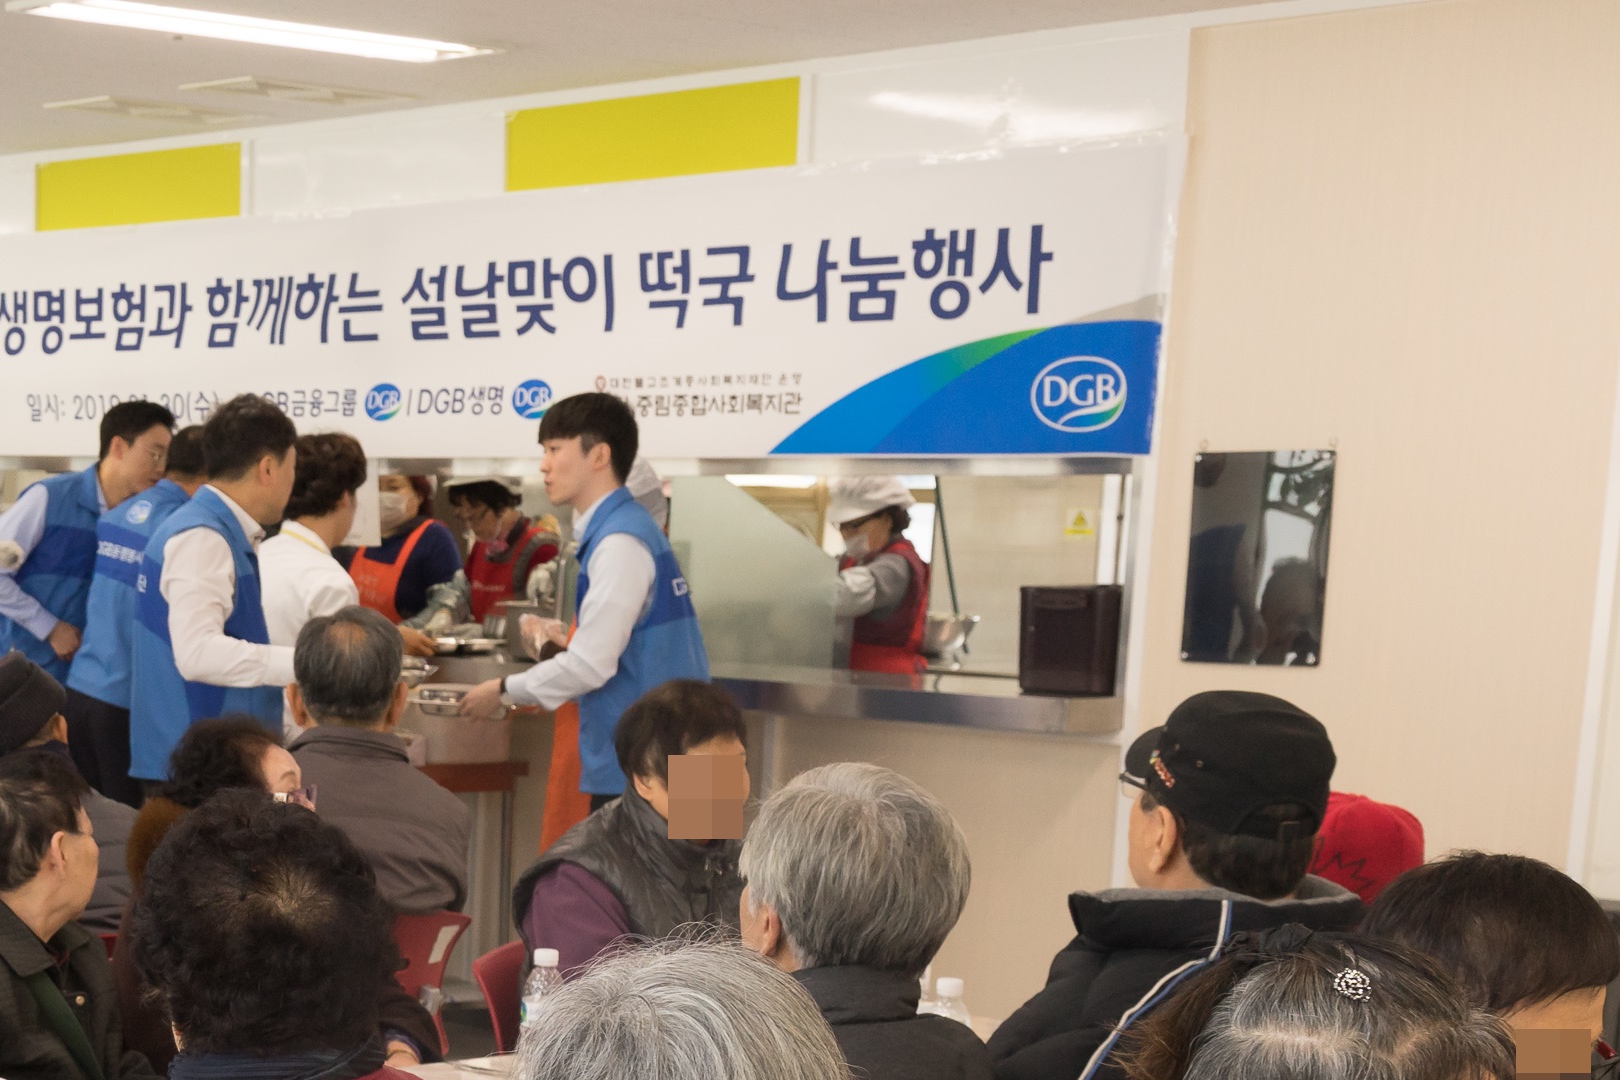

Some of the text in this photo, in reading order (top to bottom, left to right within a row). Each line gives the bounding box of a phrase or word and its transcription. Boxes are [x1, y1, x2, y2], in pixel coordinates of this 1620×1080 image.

[206, 272, 384, 348] 함께하는
[401, 254, 616, 341] 설날맞이
[639, 245, 756, 329] 떡국
[776, 222, 1054, 322] 나눔행사
[27, 393, 65, 422] 일시:
[417, 386, 505, 416] DGB생명
[1042, 373, 1117, 408] DGB
